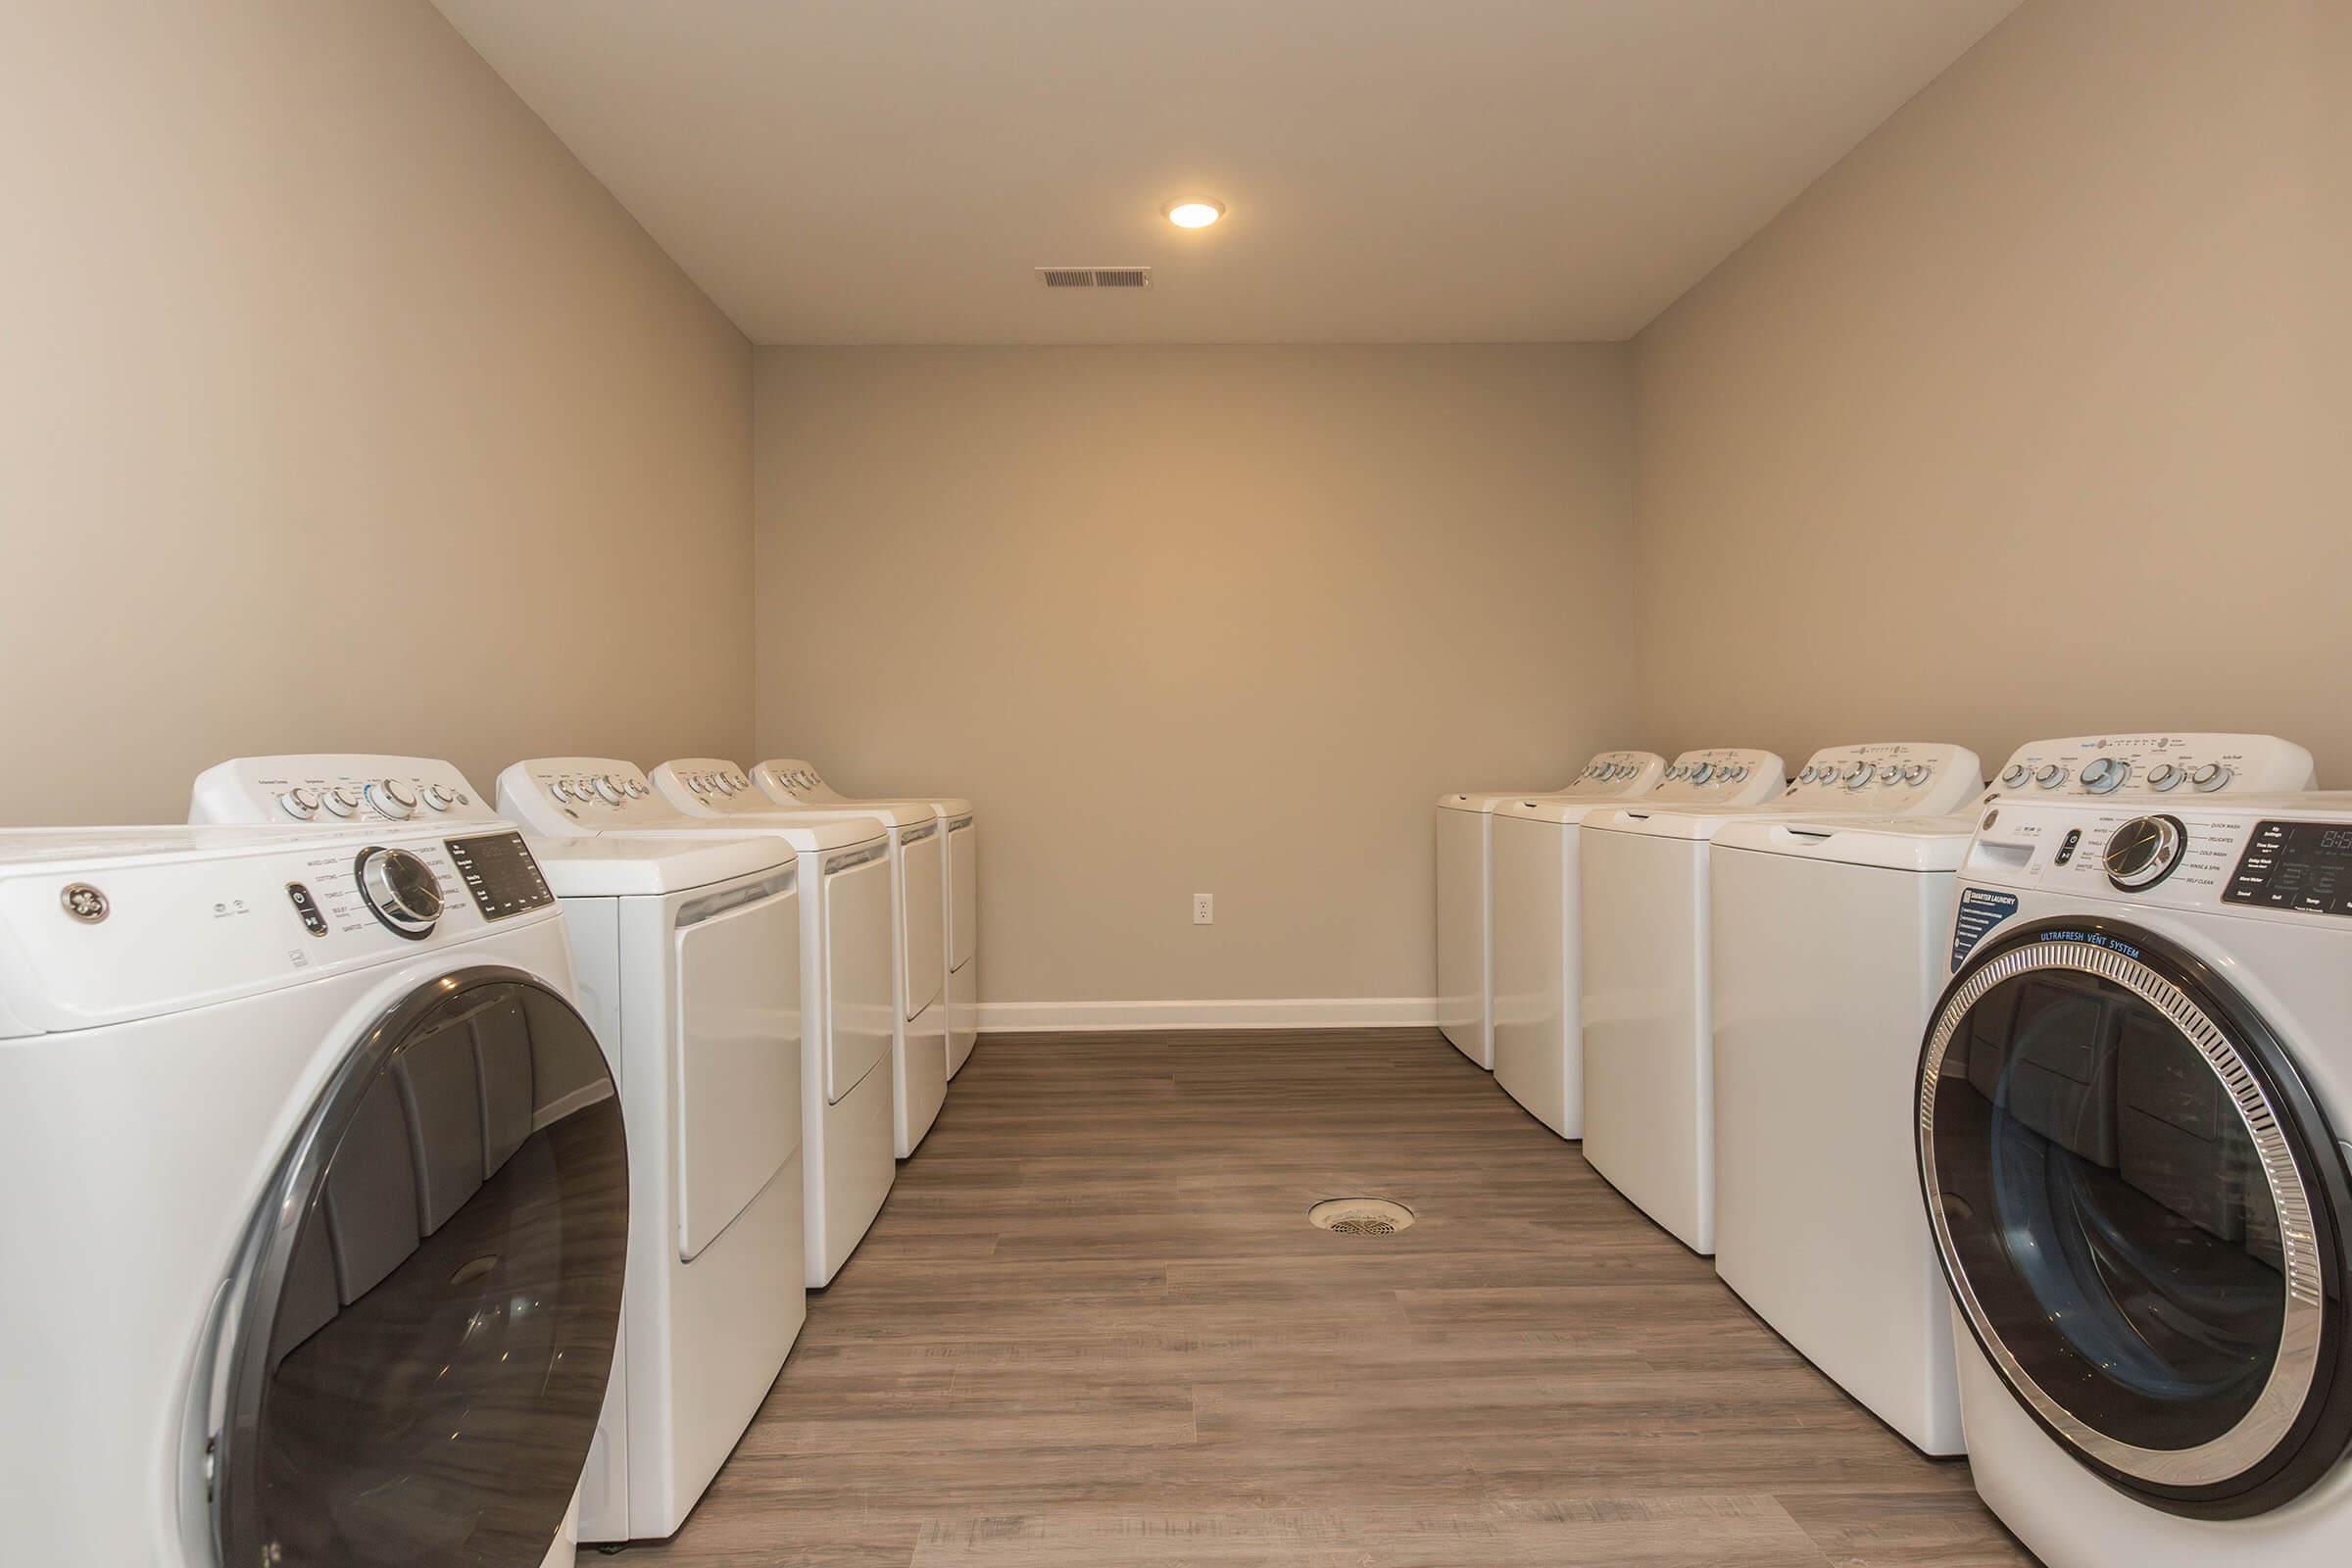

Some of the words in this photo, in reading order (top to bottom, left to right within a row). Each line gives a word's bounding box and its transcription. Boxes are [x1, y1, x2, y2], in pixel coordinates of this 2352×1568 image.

[1971, 892, 1992, 902] SMARTER
[1990, 894, 2016, 906] LAUNDRY
[2040, 931, 2084, 942] ULTRAFRESH
[2087, 934, 2107, 946] VENT
[2109, 940, 2139, 958] SYSTEM
